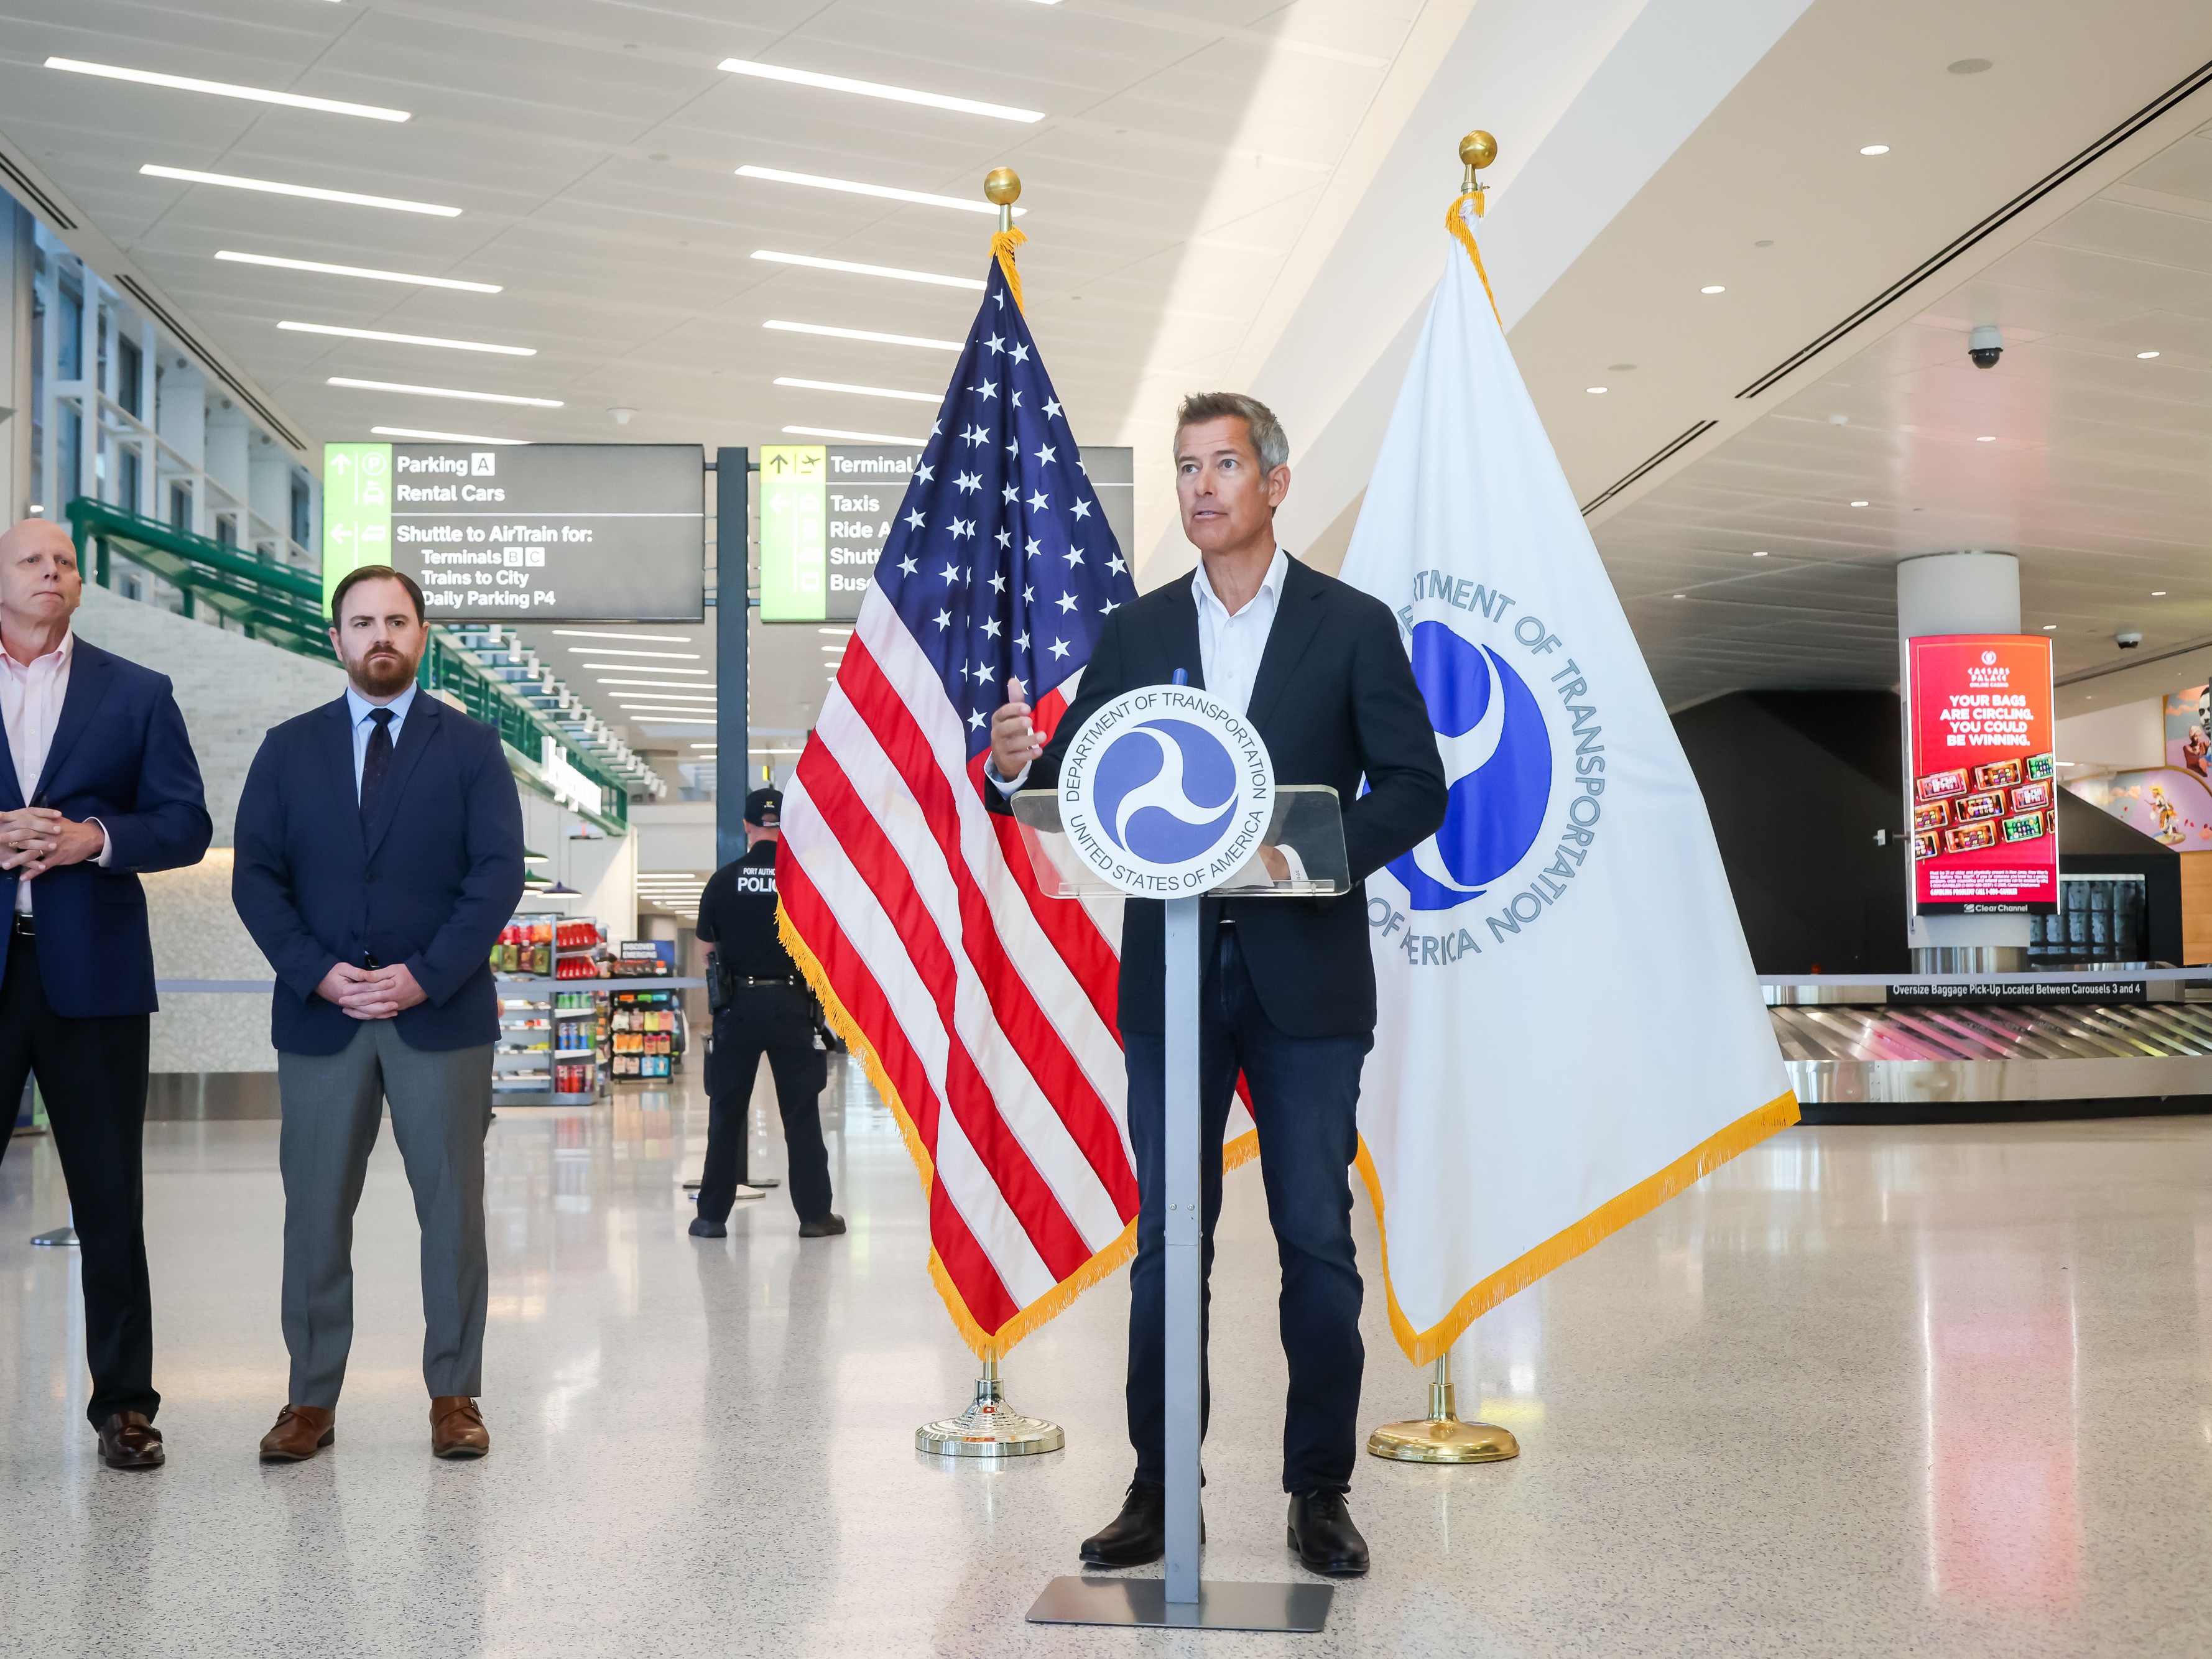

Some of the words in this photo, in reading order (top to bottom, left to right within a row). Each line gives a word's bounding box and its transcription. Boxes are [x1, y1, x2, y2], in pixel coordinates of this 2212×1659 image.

[397, 455, 468, 477] Parking
[830, 455, 913, 473] Terminal
[397, 484, 458, 502] Rental
[461, 484, 506, 502] Cars
[830, 494, 880, 512] Taxis
[396, 525, 463, 543] Shuttle
[466, 526, 486, 543] to
[488, 525, 558, 543] AirTrain
[562, 525, 593, 543] for:
[830, 520, 874, 538] Ride
[420, 548, 502, 565] Terminals
[830, 547, 883, 565] Shutt
[420, 570, 472, 585] Trains
[474, 570, 493, 585] to
[496, 570, 530, 588] City
[423, 590, 464, 609] Daily
[467, 590, 530, 609] Parking
[534, 590, 556, 606] P4
[1514, 616, 1562, 655] OF
[1948, 695, 1990, 707] YOUR
[1992, 694, 2027, 707] BAGS
[1940, 708, 1970, 721] ARE
[1973, 708, 2034, 721] CIRCLING.
[1949, 721, 1981, 733] YOU
[1983, 721, 2028, 733] COULD
[1066, 700, 1132, 802] DEPARTMENT
[1134, 693, 1157, 710] OF
[1162, 692, 1267, 799] TRANSPORTATION
[1946, 734, 1966, 747] BE
[1968, 734, 2031, 746] WINNING.
[1486, 659, 1606, 944] TRANSPORTATION
[1070, 815, 1113, 870] UNITED
[1113, 865, 1180, 890] STATES
[1183, 869, 1206, 887] OF
[1210, 810, 1264, 877] AMERICA
[1367, 897, 1405, 937] OF
[1975, 904, 1997, 912] Clear
[1997, 904, 2028, 913] Channel
[1893, 984, 1929, 996] Oversize
[1931, 984, 1968, 997] Baggage
[1969, 984, 2001, 997] Pick-Up
[2002, 984, 2035, 995] Located
[2036, 984, 2070, 994] Between
[2071, 984, 2111, 994] Carousels
[2113, 984, 2117, 994] 3
[2119, 984, 2133, 994] and
[2135, 984, 2140, 994] 4
